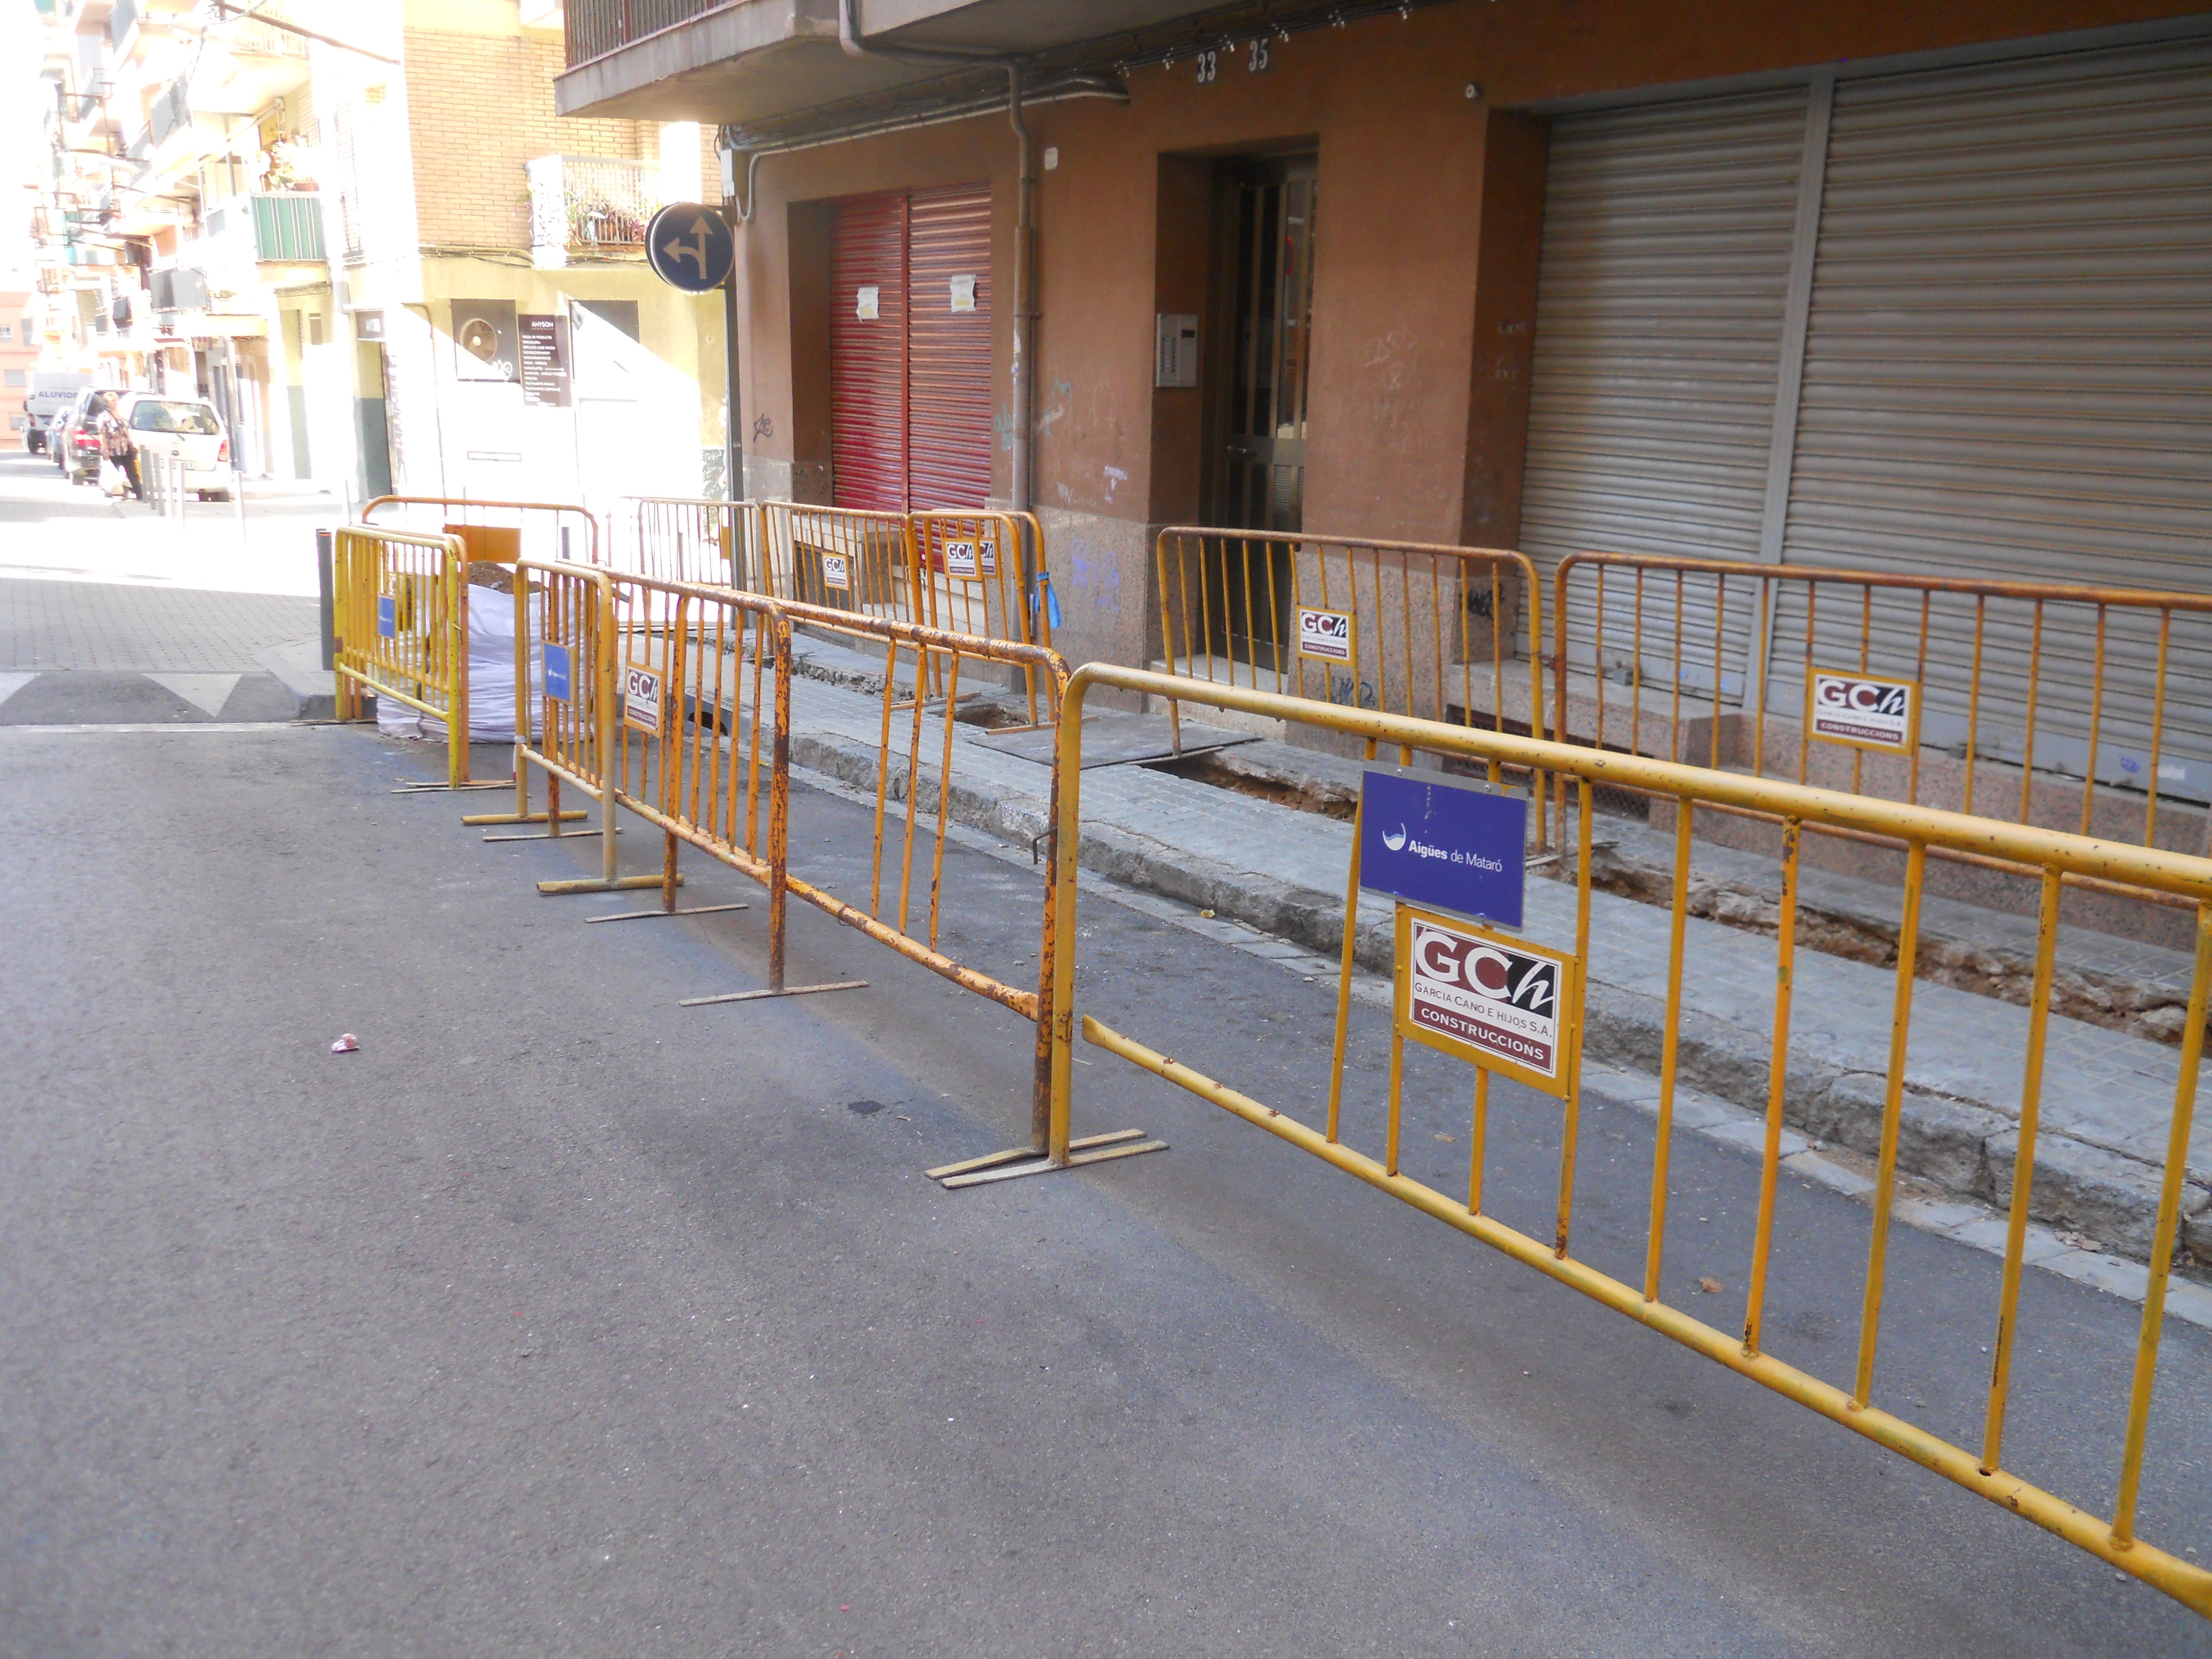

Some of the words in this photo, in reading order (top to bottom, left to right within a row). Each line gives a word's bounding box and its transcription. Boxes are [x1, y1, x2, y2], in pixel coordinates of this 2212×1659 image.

[1198, 51, 1216, 82] 33
[1249, 38, 1269, 71] 35
[1301, 613, 1347, 637] GCh
[1305, 643, 1345, 655] CONSTRUCCIONS
[1818, 680, 1905, 714] GCh
[1820, 722, 1899, 740] CONSTRUCCIONS
[1408, 840, 1448, 860] Aigües
[1451, 849, 1464, 863] de
[1466, 852, 1503, 872] Mataró
[1415, 931, 1555, 1010] GCh
[1415, 983, 1452, 1003] GARCIA
[1454, 996, 1485, 1014] CANO
[1488, 1008, 1494, 1017] E
[1497, 1012, 1527, 1029] HIJOS
[1529, 1021, 1552, 1038] S.A.
[1421, 1008, 1545, 1061] CONSTRUCCIONS
